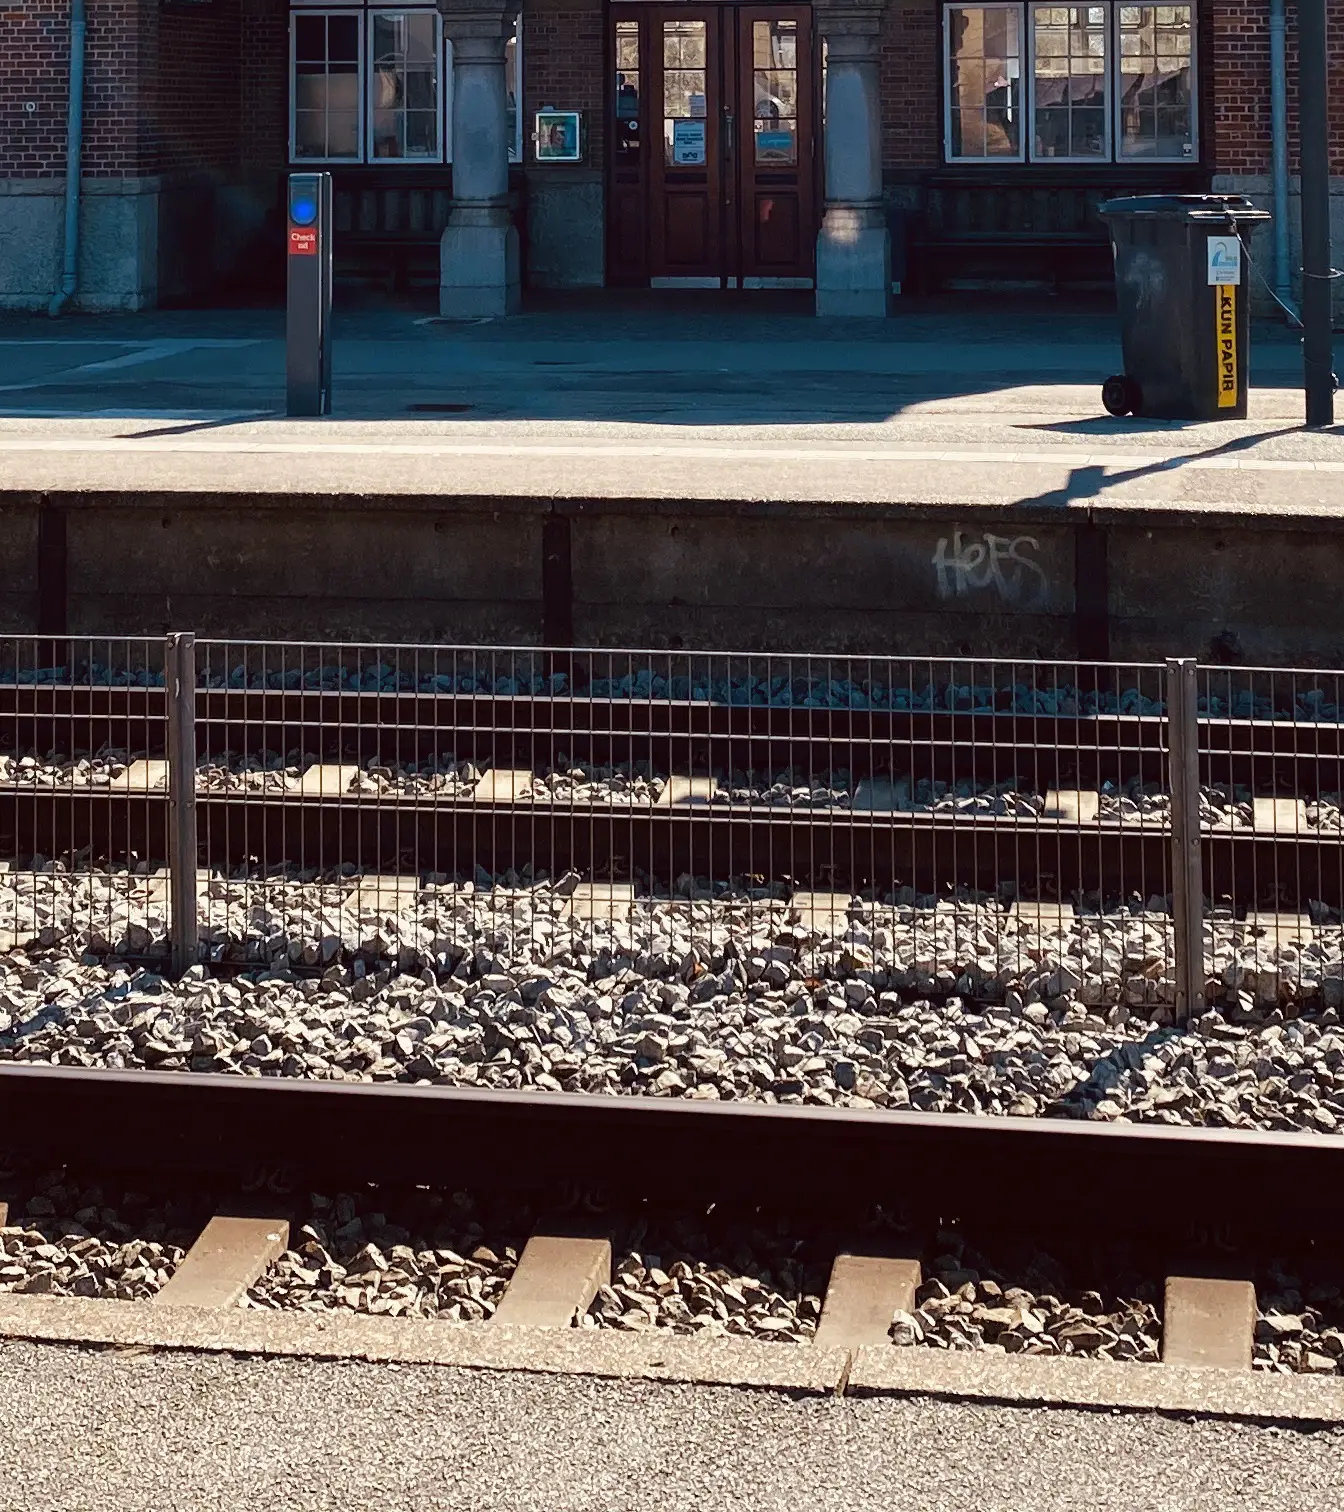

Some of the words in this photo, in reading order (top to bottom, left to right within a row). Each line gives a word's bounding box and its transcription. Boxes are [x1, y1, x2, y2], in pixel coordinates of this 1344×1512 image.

[291, 232, 316, 242] Check
[1220, 296, 1232, 335] KUN
[1221, 338, 1235, 392] PAPIR
